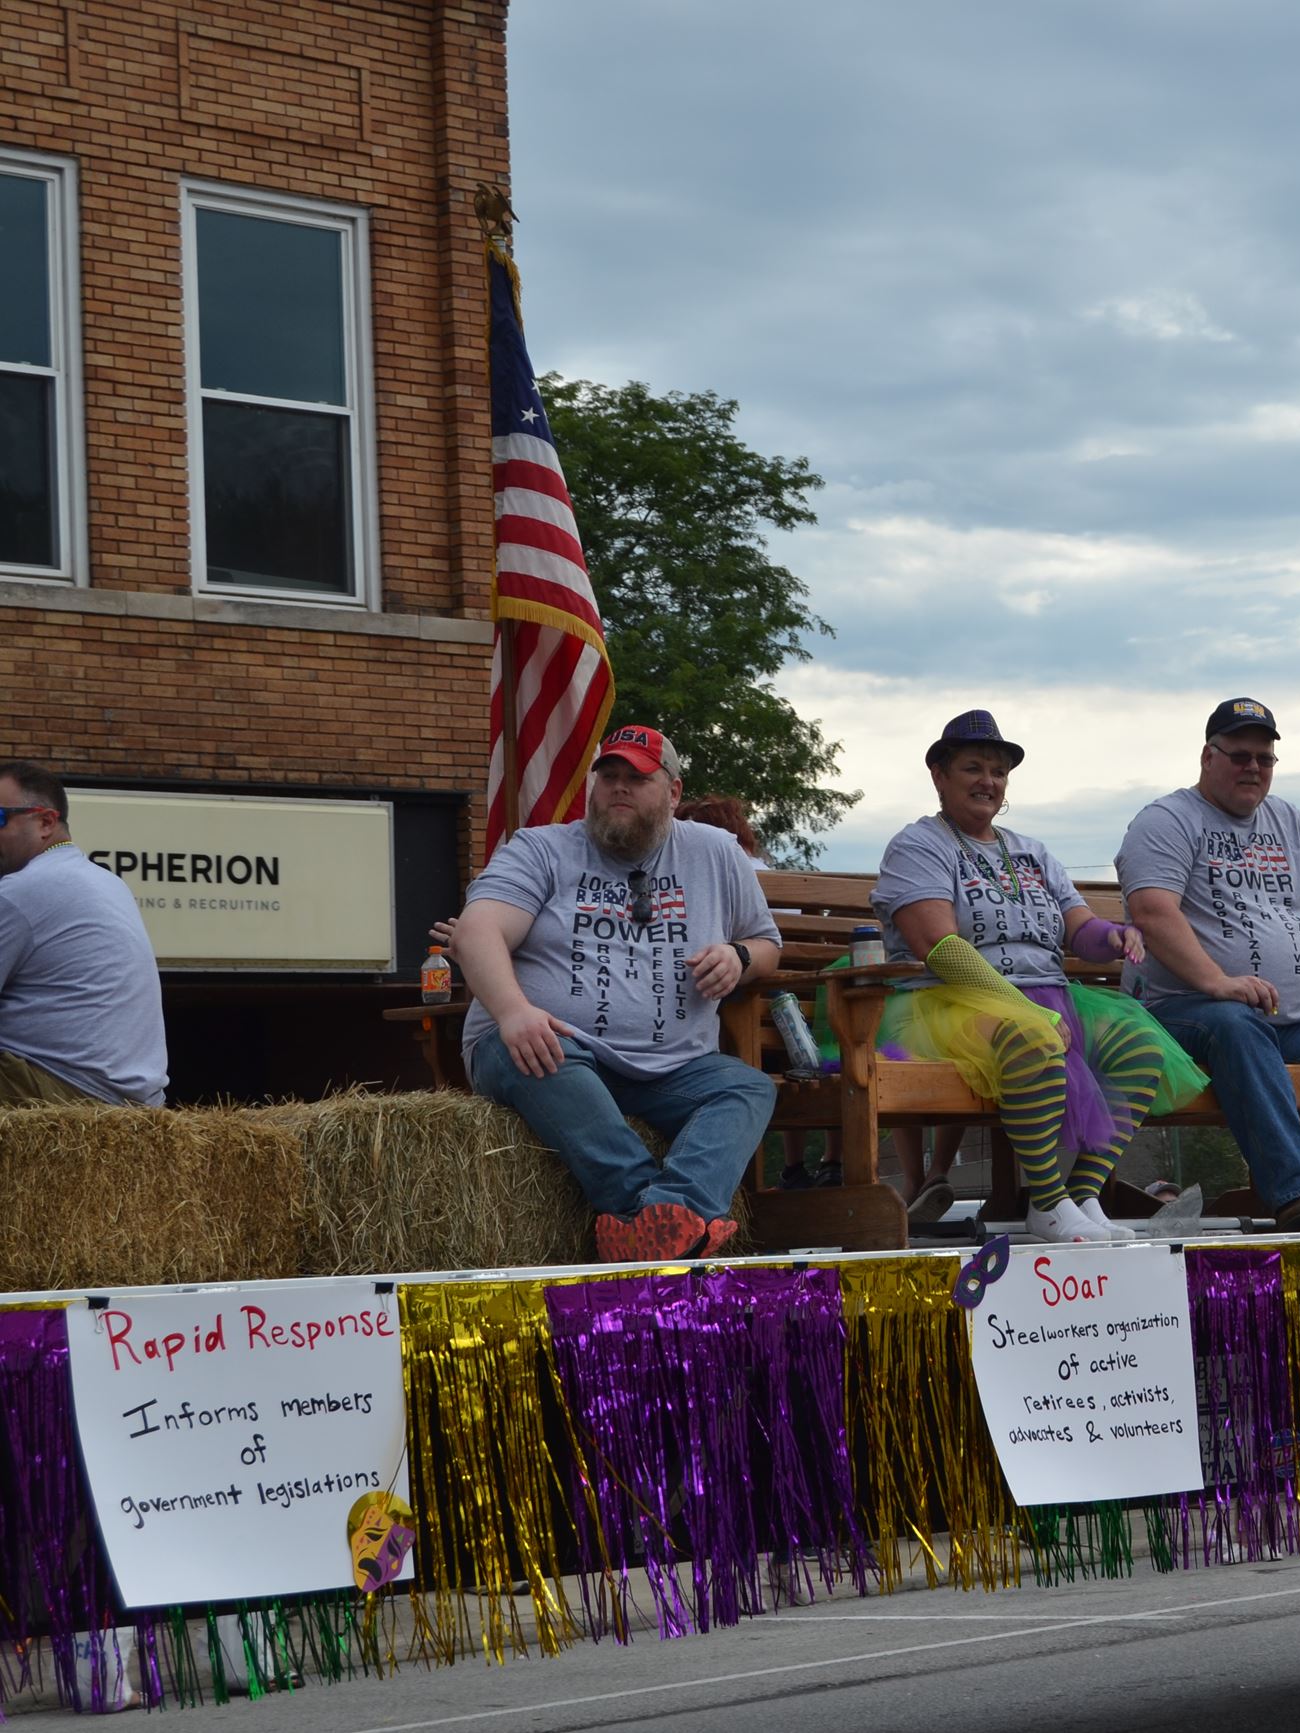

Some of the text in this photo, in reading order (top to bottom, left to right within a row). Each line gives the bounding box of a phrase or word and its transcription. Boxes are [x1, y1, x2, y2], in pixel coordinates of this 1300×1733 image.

[608, 729, 648, 748] USA
[89, 851, 279, 885] SPHERION
[1208, 866, 1294, 893] POWER
[174, 898, 182, 909] &
[189, 898, 280, 912] RECRUITING
[572, 912, 688, 943] POWER
[1034, 1256, 1108, 1306] Soar
[99, 1305, 394, 1371] Rapid Response
[987, 1313, 1179, 1349] Steelworkers organization
[1090, 1351, 1138, 1373] active
[123, 1393, 372, 1438] Informs members
[1009, 1425, 1073, 1445] advocates
[1086, 1420, 1103, 1443] &
[1110, 1418, 1183, 1440] volunteers
[240, 1434, 266, 1465] of
[121, 1470, 380, 1529] government legislations
